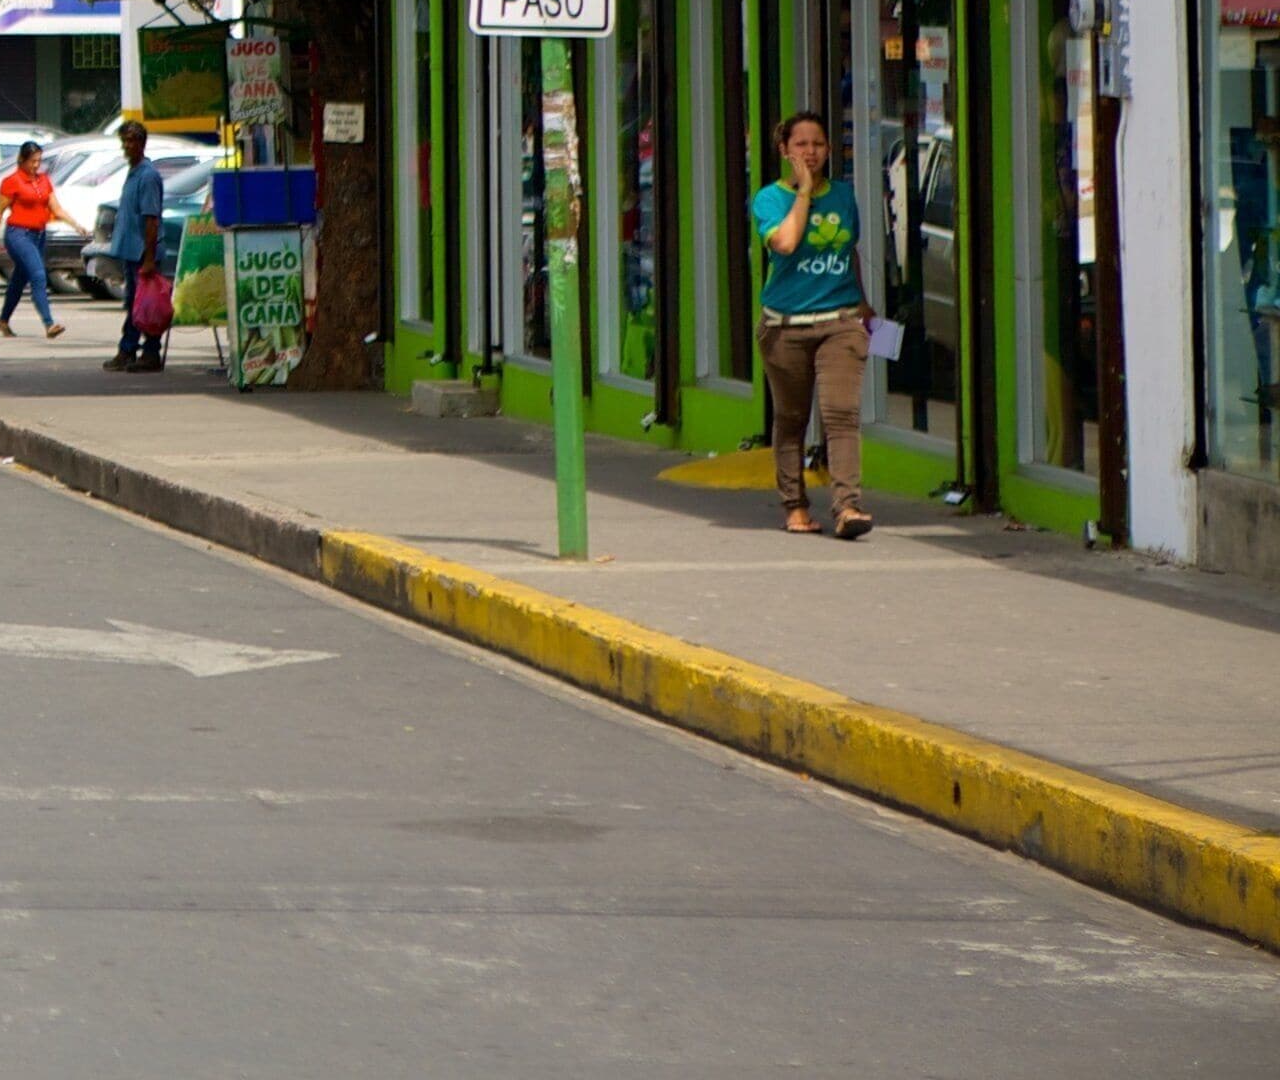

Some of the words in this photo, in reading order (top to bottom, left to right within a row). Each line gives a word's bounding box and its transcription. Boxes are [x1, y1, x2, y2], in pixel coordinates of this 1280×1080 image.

[231, 41, 276, 57] JUGO
[240, 251, 297, 271] JUGO
[797, 252, 850, 275] kölbi
[256, 275, 285, 296] DE
